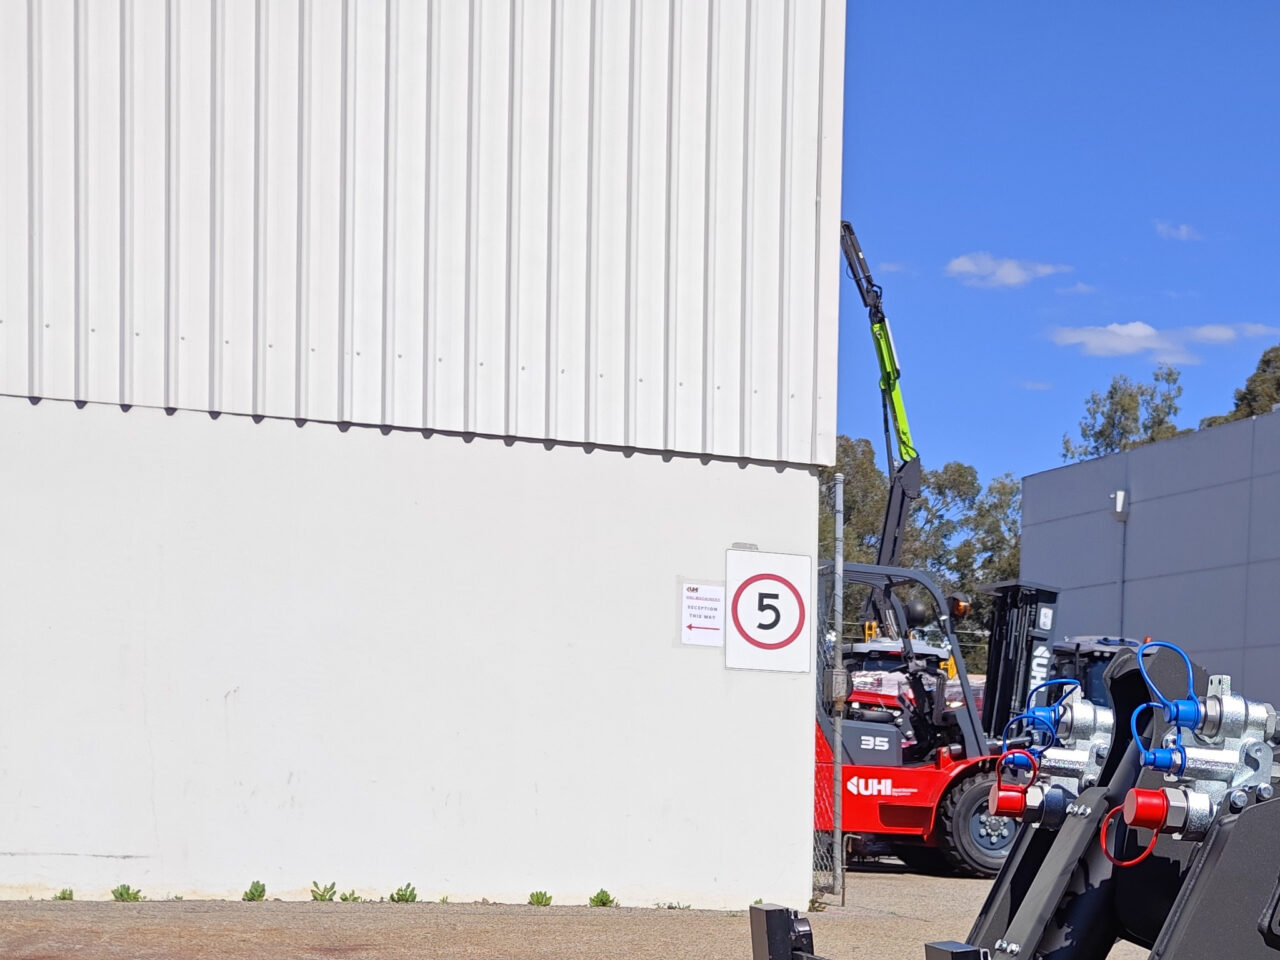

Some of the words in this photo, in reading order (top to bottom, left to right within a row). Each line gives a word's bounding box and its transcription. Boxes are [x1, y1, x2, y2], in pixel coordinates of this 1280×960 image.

[757, 592, 781, 630] 5
[1030, 657, 1049, 692] UHI
[860, 736, 890, 751] 35
[858, 778, 893, 796] UHI
